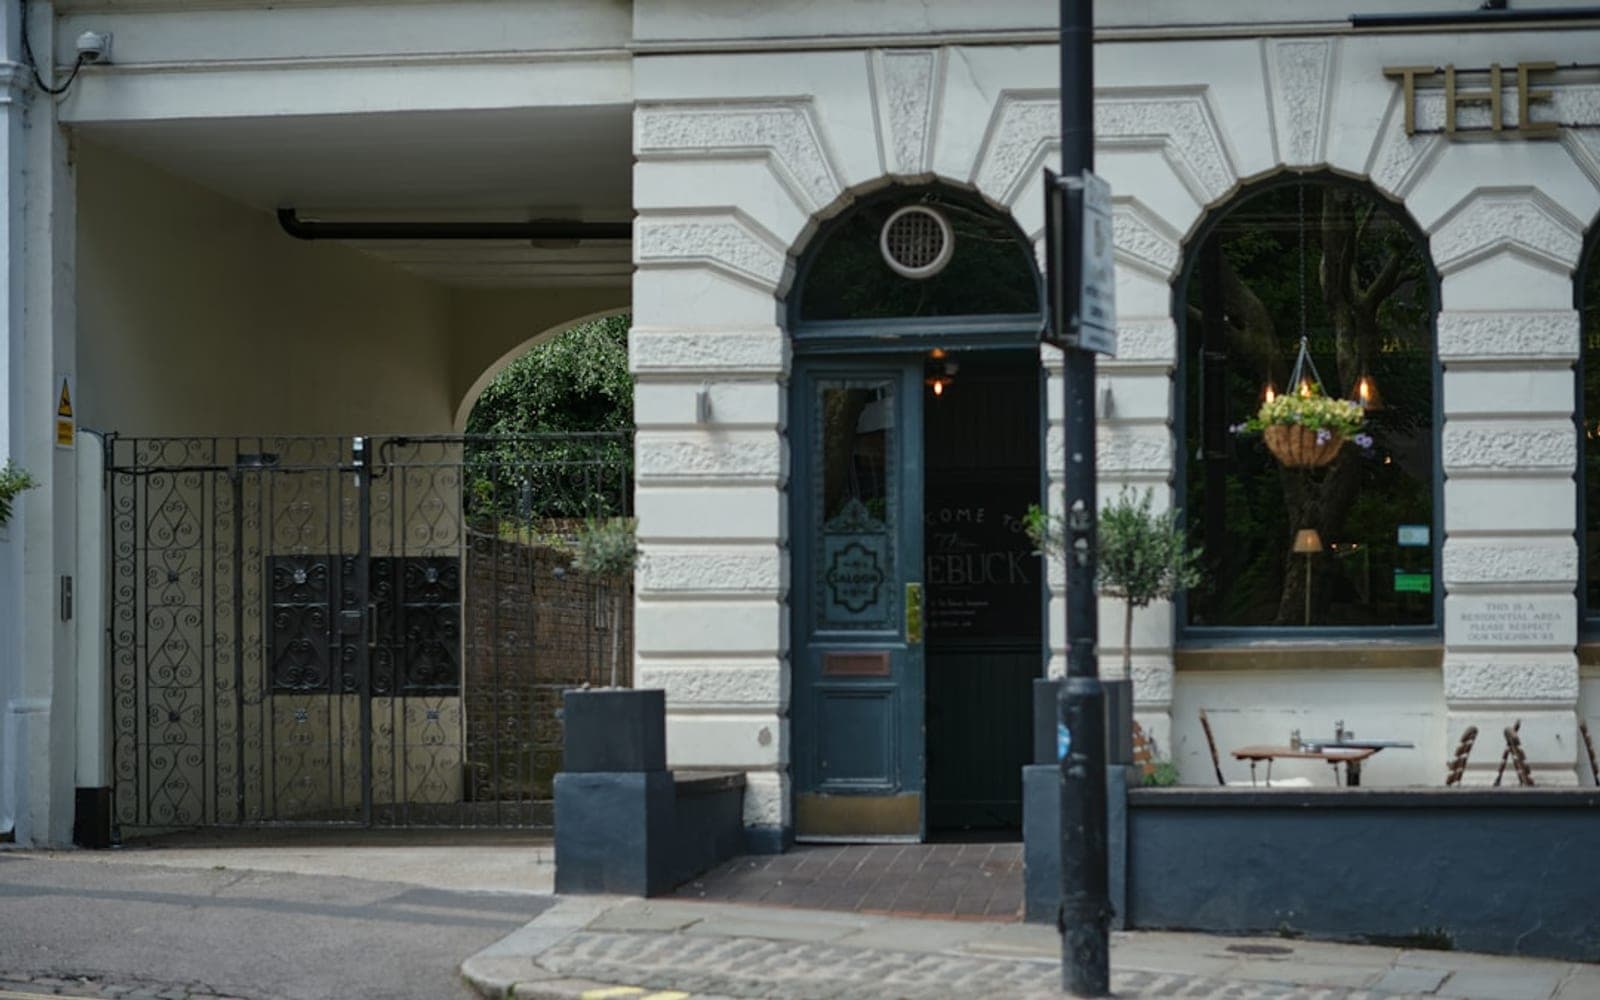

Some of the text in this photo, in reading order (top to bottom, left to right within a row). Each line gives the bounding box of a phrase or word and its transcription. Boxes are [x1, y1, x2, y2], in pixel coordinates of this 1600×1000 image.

[1382, 61, 1559, 136] THE
[926, 507, 985, 525] COME
[927, 551, 1032, 585] EBUCK
[1486, 602, 1535, 611] THIS IS A
[1461, 611, 1561, 622] RESIDENTIAL AREA
[1470, 622, 1552, 631] PLEASE RESPECT
